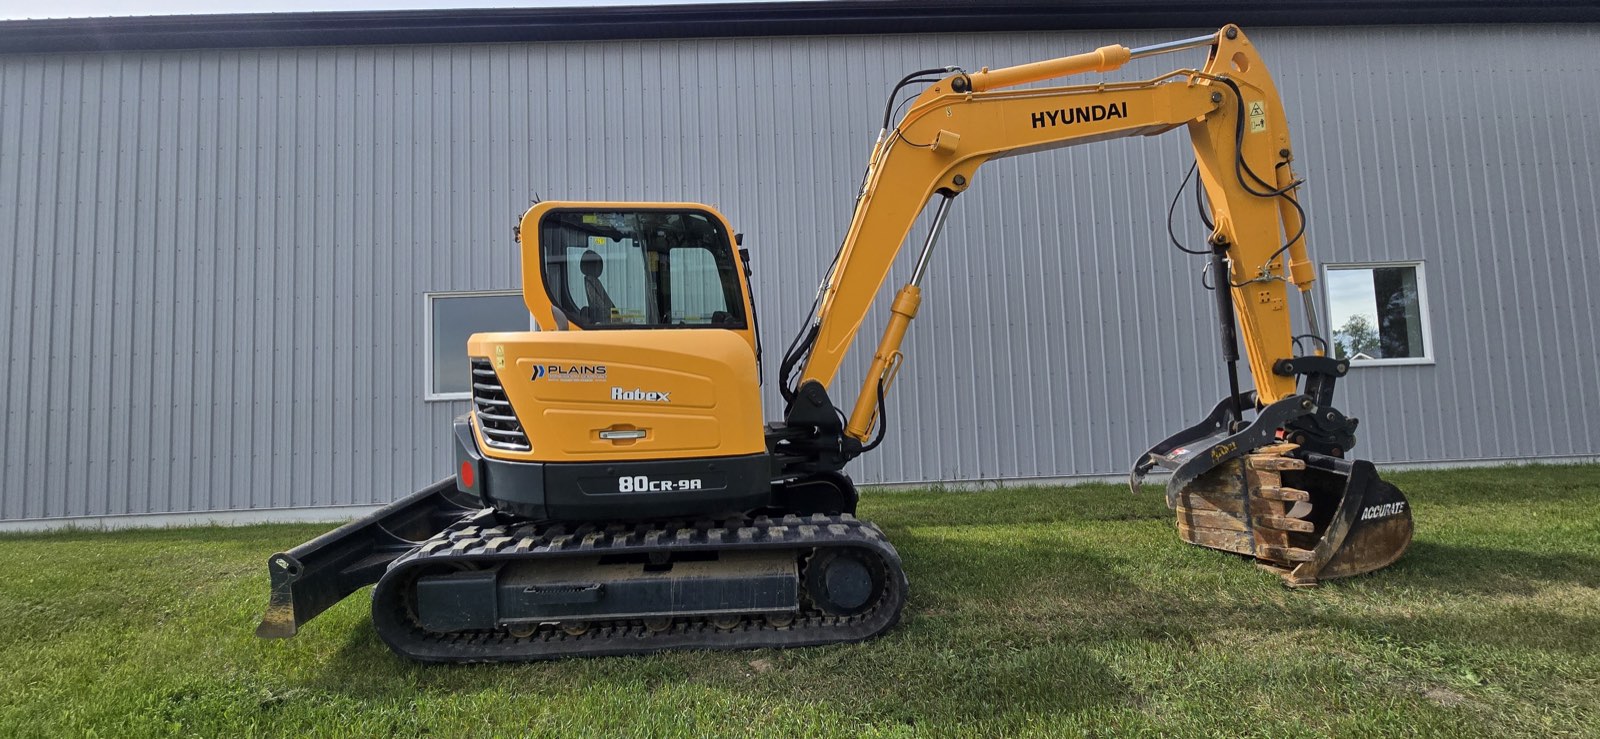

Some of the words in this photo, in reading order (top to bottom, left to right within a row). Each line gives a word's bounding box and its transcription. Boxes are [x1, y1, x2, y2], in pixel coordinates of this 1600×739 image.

[1031, 102, 1127, 128] HYUNDAI
[548, 365, 607, 375] PLAINS
[611, 386, 671, 403] Robex
[618, 475, 702, 493] 80CR-9A
[1361, 501, 1405, 520] ACCURATE
